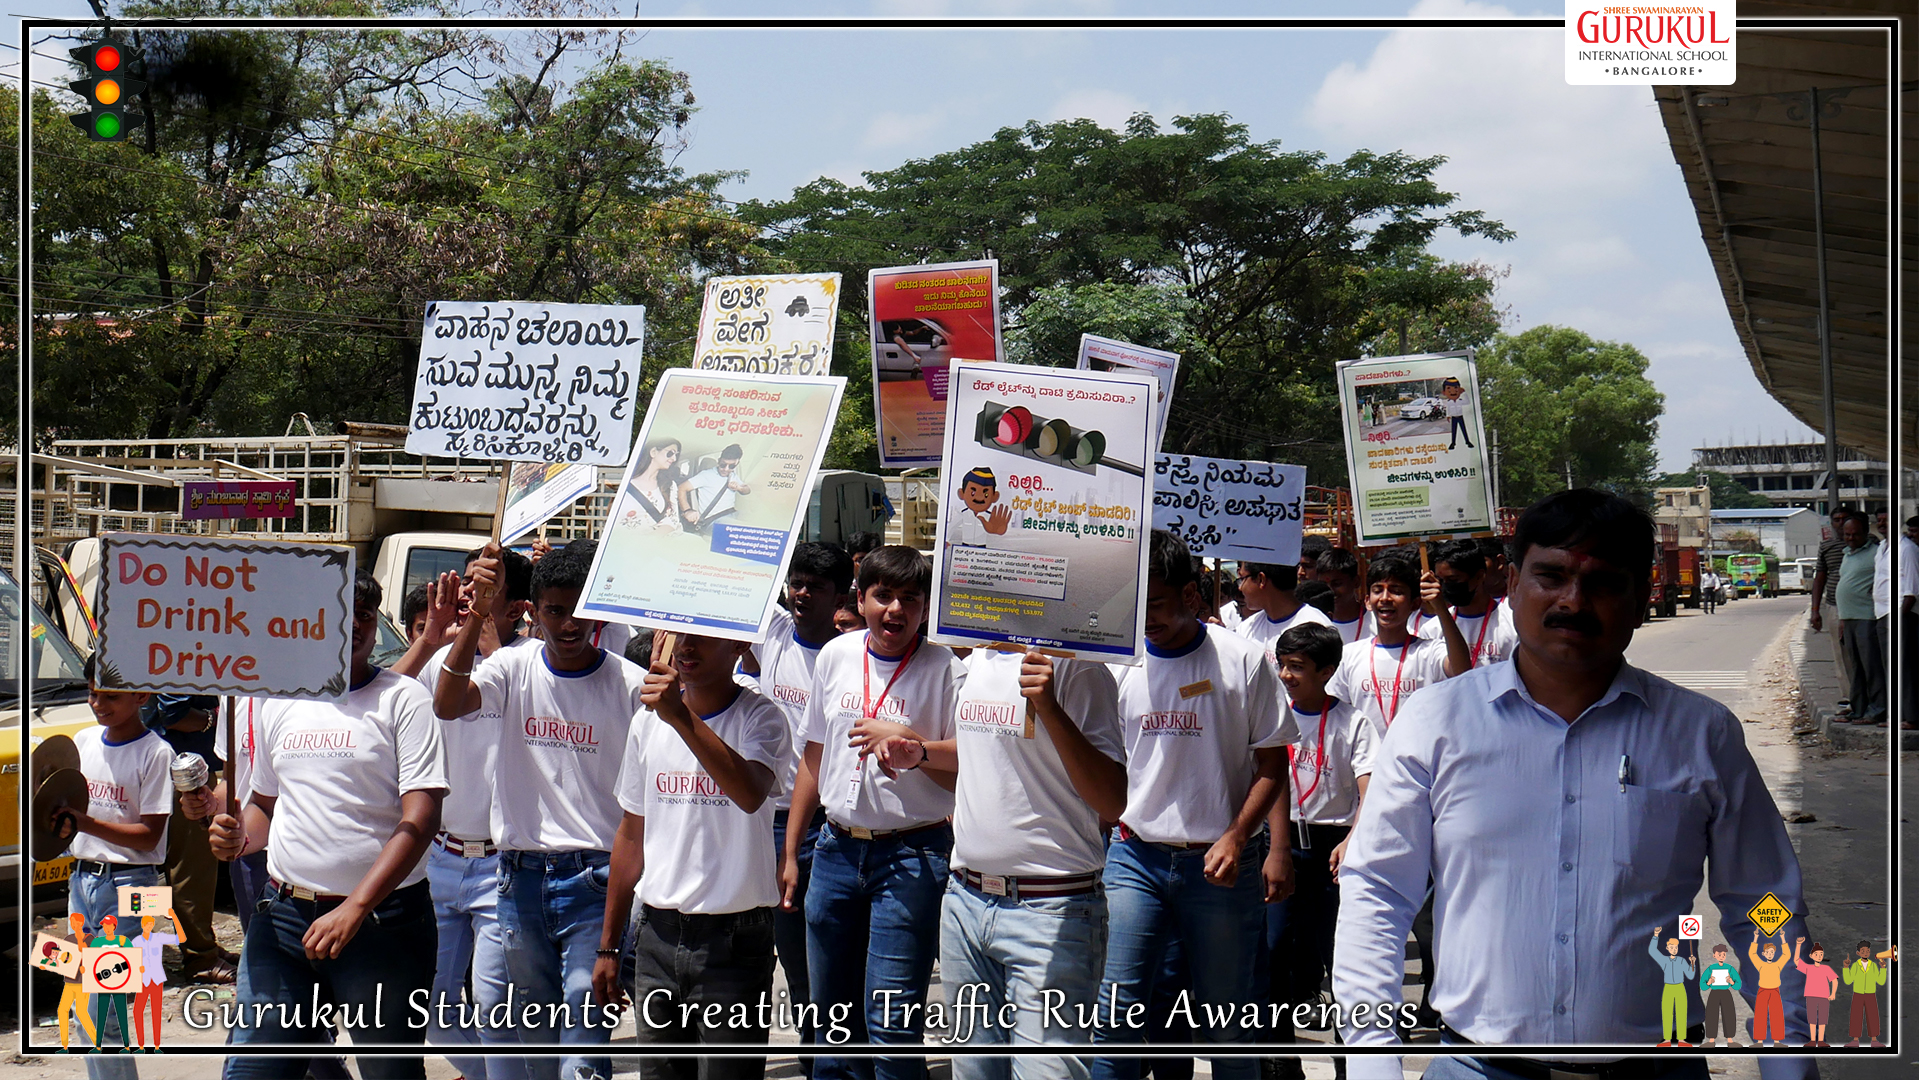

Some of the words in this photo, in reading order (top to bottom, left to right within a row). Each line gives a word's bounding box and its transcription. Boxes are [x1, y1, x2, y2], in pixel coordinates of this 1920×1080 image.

[716, 312, 770, 342] ವೇಗ
[484, 352, 561, 404] ಮುನ್ನ
[568, 359, 630, 420] ನಿಮ್ಮ
[681, 384, 722, 400] ಕಾರಿನಲ್ಲಿ
[722, 387, 782, 402] ಸಂಚರಿಸುವ
[973, 380, 995, 391] ರೆಡ್
[1039, 387, 1064, 397] ದಾಟಿ
[756, 408, 788, 419] ಸೀಟ್
[1204, 462, 1285, 492] ನಿಯಮ
[1387, 470, 1434, 484] ಜೀವಗಳನ್ನು
[190, 488, 203, 509] ಶ್ರೀ
[1011, 496, 1032, 510] ರೆಡ್
[1034, 499, 1056, 519] ಲೈಟ್
[1022, 518, 1080, 539] ಜೀವಗಳನ್ನು
[1083, 524, 1125, 538] ಉಳಿಸಿರಿ
[119, 552, 167, 586] Do
[185, 556, 258, 592] Not
[137, 596, 250, 637] Drink
[267, 608, 325, 640] and
[148, 642, 259, 681] Drive
[960, 700, 1021, 726] GURUKUL
[282, 730, 357, 751] GURUKUL
[995, 728, 1019, 737] SCHOOL
[280, 752, 325, 760] INTERNATIONAL
[701, 798, 730, 806] SCHOOL
[35, 869, 46, 881] KA
[50, 867, 60, 879] 50
